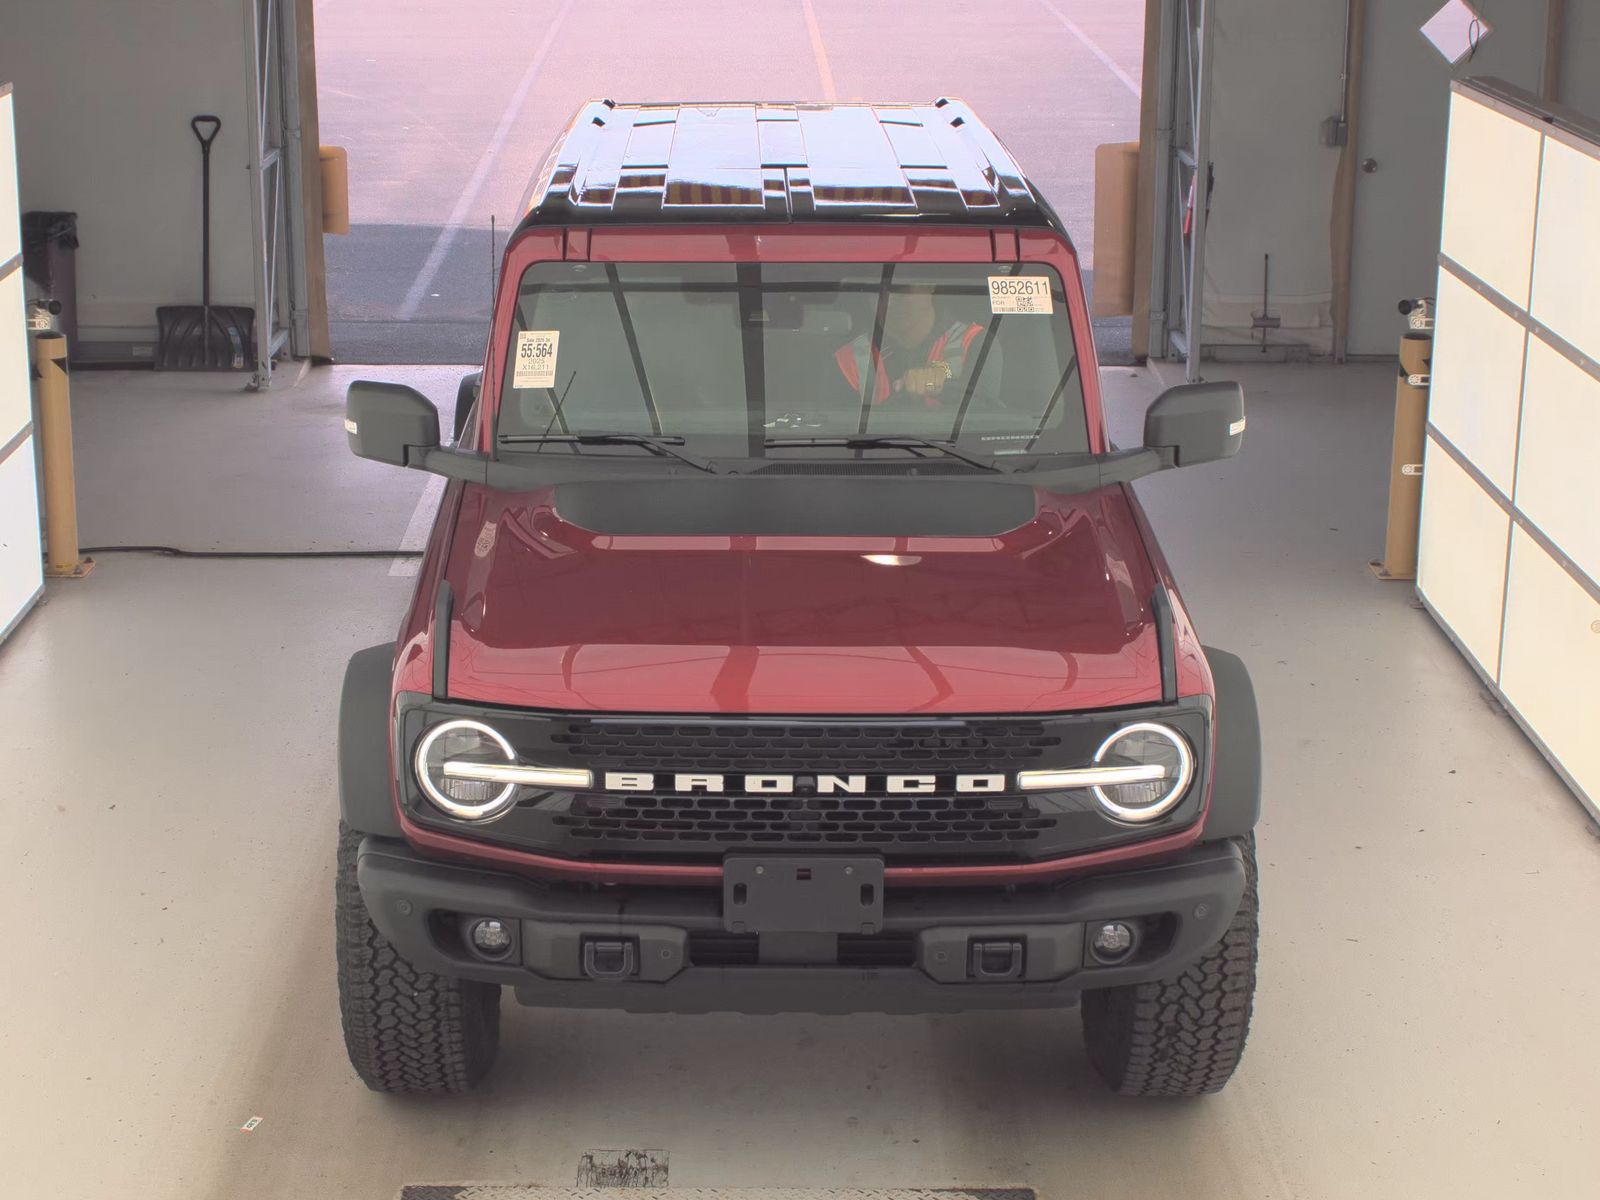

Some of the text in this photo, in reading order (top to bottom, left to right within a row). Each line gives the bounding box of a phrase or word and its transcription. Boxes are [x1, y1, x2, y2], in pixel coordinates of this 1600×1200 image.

[991, 280, 1048, 295] 9852611
[520, 343, 553, 358] 55:564
[605, 772, 1006, 793] BRONCO
